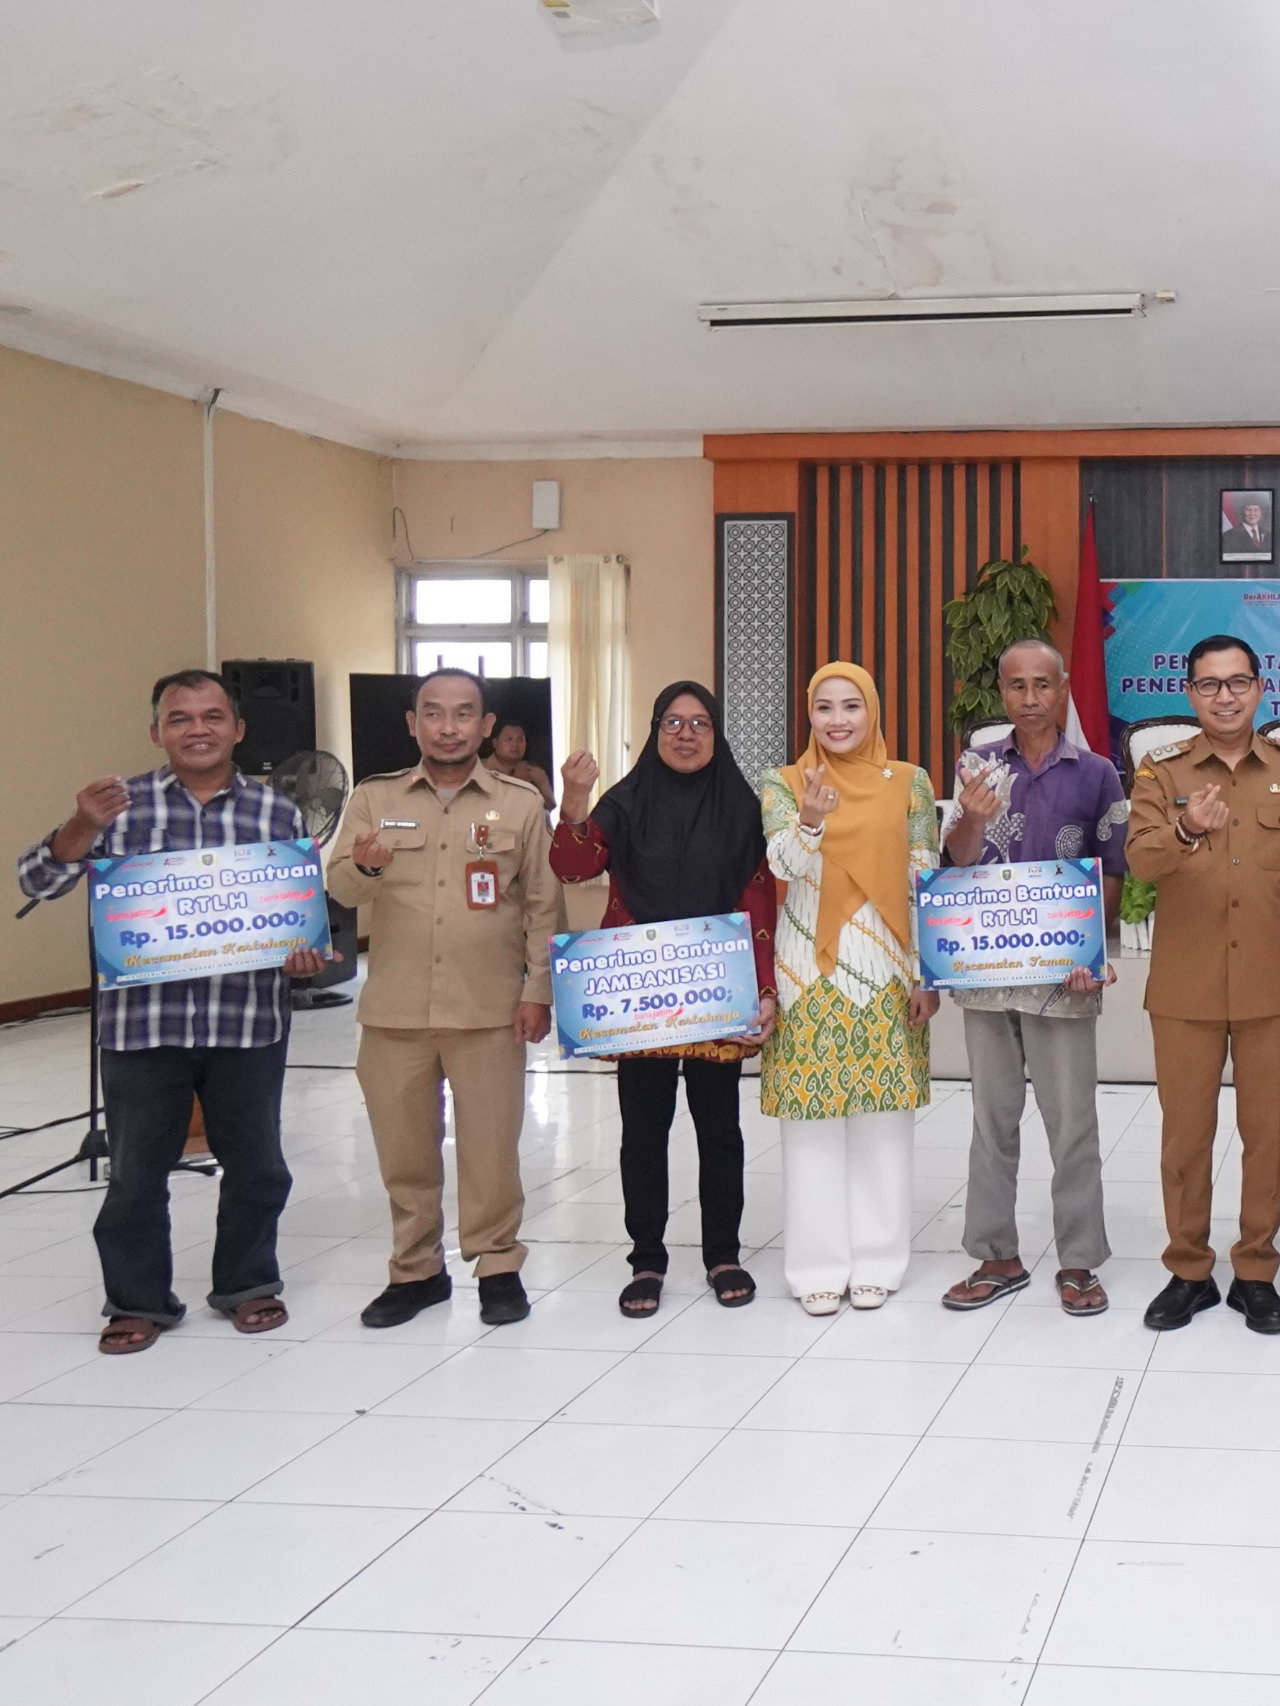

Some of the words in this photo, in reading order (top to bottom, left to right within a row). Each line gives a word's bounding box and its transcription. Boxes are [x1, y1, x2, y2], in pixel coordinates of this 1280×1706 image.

[95, 874, 214, 900] Penerima
[219, 862, 319, 887] Bantuan
[177, 891, 248, 917] RTLH
[919, 886, 1012, 908] Penerima
[1015, 882, 1098, 903] Bantuan
[119, 929, 159, 949] Rp.
[166, 910, 308, 941] 15.000.000;
[981, 907, 1038, 928] RTLH
[936, 936, 966, 956] Rp.
[971, 929, 1086, 951] 15.000.000;
[124, 946, 218, 968] Kecamatan
[554, 948, 657, 975] Penerima
[661, 937, 749, 962] Bantuan
[952, 957, 1024, 974] Kecamatan
[1028, 955, 1074, 967] Taman
[583, 961, 727, 997] JAMBANISASI
[581, 1002, 615, 1022] Rp.
[578, 1020, 659, 1041] Kecamatan
